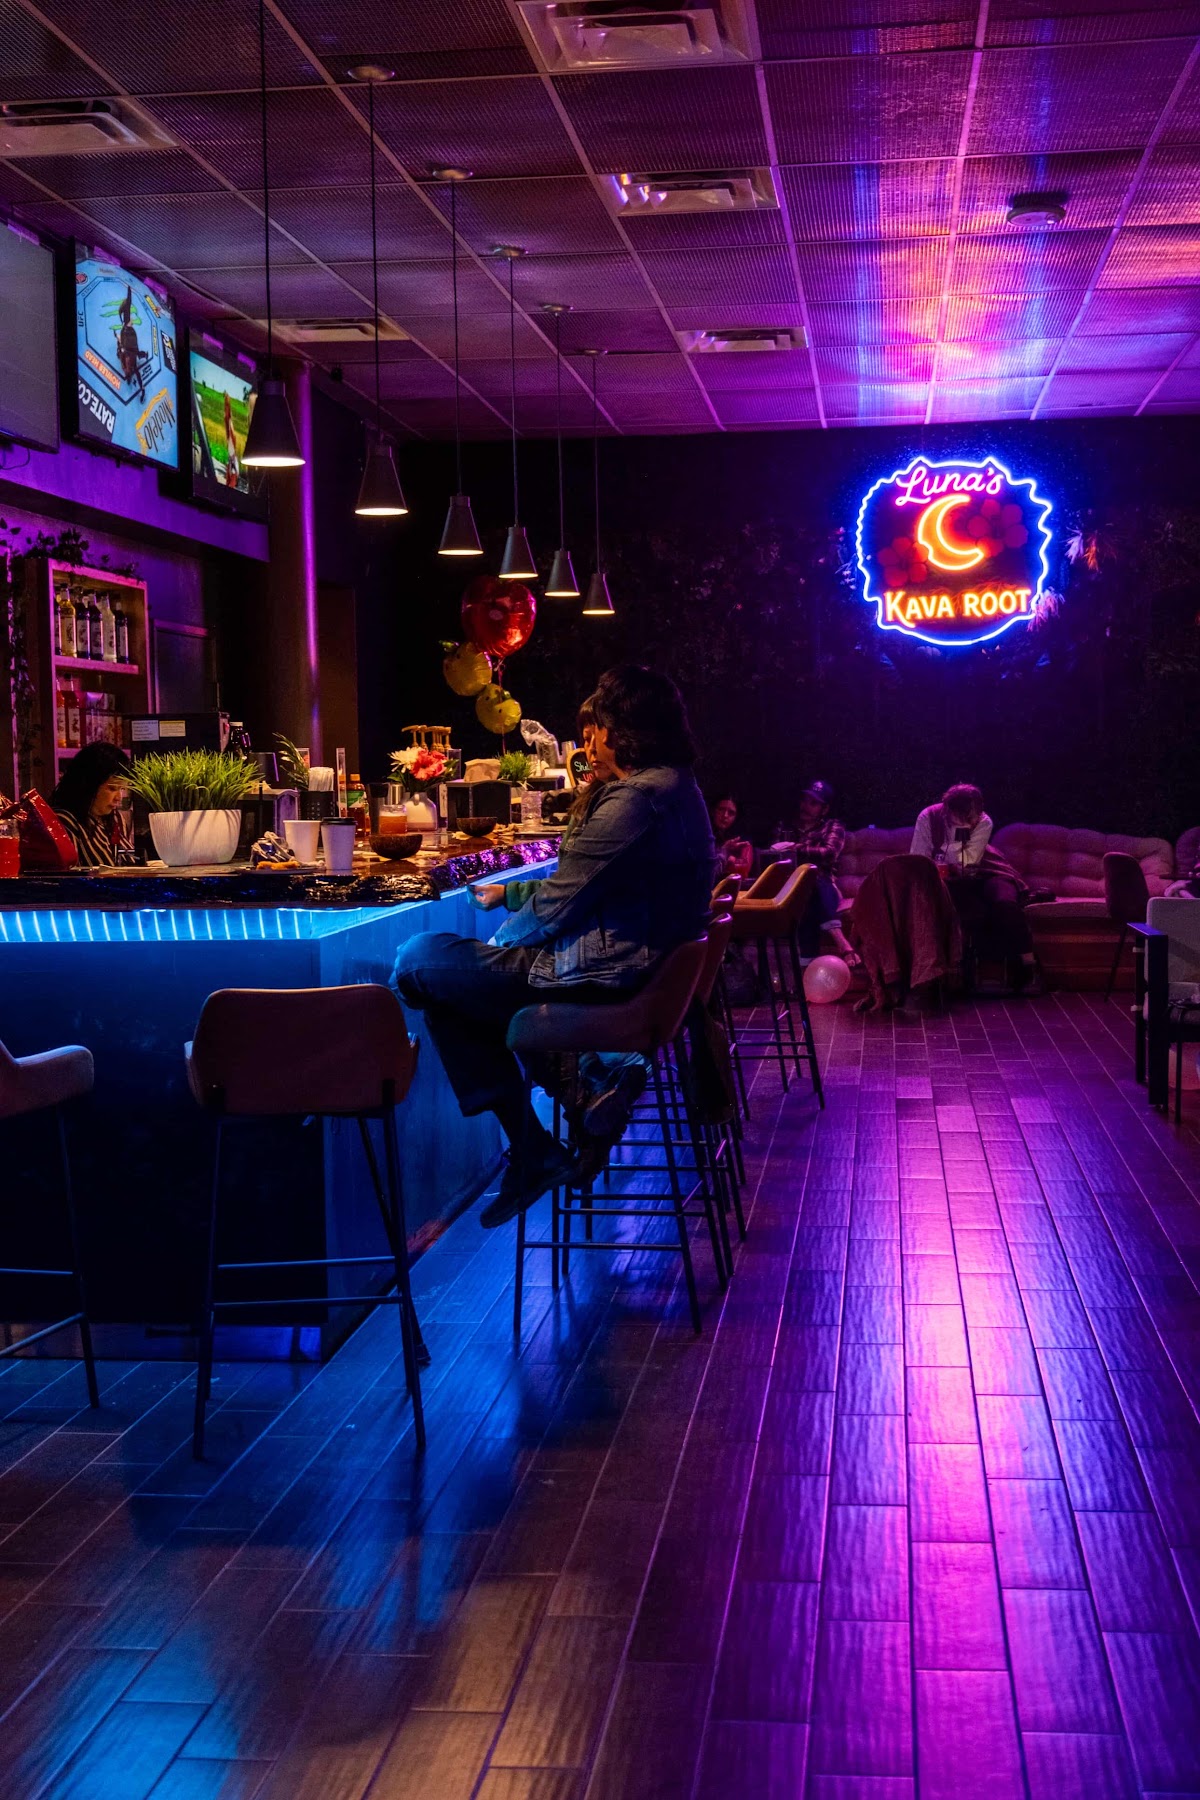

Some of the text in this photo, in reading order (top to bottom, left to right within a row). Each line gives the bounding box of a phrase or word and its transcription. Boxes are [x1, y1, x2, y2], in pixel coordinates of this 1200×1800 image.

[78, 380, 115, 434] RATE.CO
[144, 397, 175, 453] Modelo
[895, 466, 1004, 506] Luna's
[963, 588, 1032, 617] ROOT
